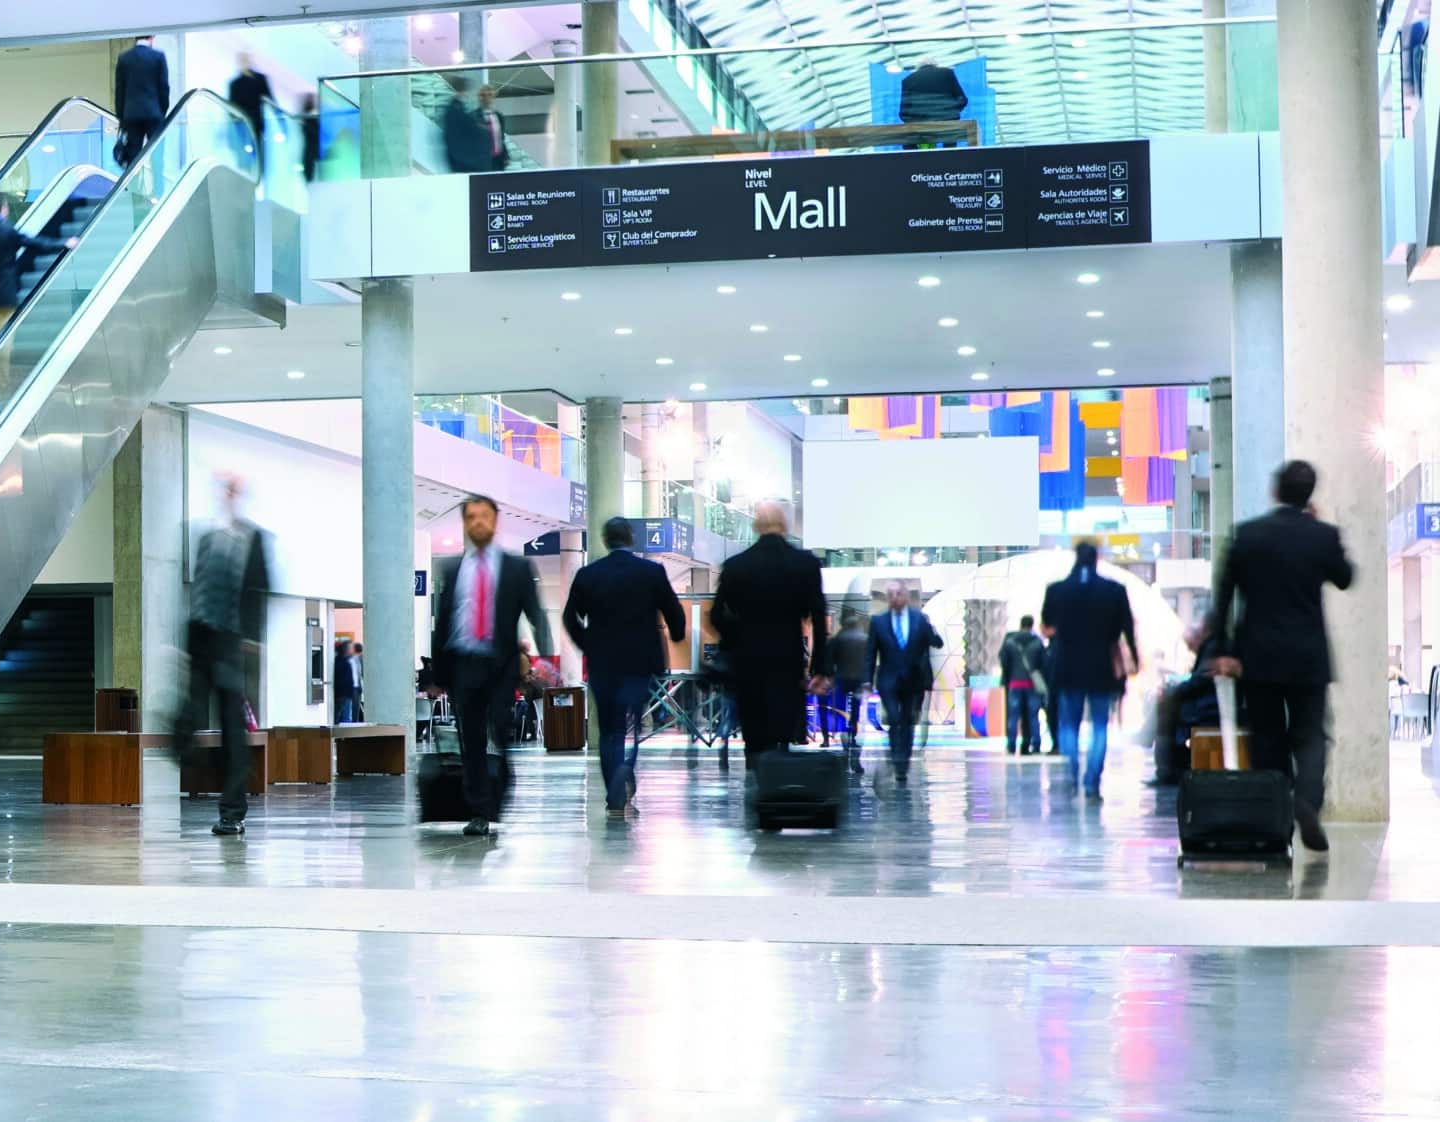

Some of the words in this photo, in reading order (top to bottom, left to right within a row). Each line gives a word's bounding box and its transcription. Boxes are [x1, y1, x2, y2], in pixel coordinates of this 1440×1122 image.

[745, 167, 772, 180] Nivel
[1042, 165, 1073, 175] Servicio
[911, 173, 943, 183] Oficinas
[943, 172, 983, 181] Certamen
[745, 180, 768, 188] LEVEL
[506, 192, 525, 201] Salas
[526, 191, 536, 200] de
[537, 190, 576, 199] Reuniones
[622, 187, 670, 196] Restaurantes
[1040, 190, 1057, 199] Sala
[1058, 187, 1108, 197] Autoridades
[622, 209, 638, 218] Sala
[639, 209, 653, 217] VIP
[754, 185, 846, 231] Mall
[507, 213, 534, 222] Bancos
[1038, 211, 1074, 222] Agencias
[1075, 210, 1086, 219] de
[1087, 209, 1108, 220] Viaje
[908, 218, 944, 227] Gabinete
[945, 216, 956, 225] de
[957, 216, 983, 225] Prensa
[507, 234, 539, 243] Servicios
[622, 231, 640, 240] Club
[640, 230, 653, 239] del
[654, 229, 698, 240] Comprador
[650, 531, 661, 545] 4
